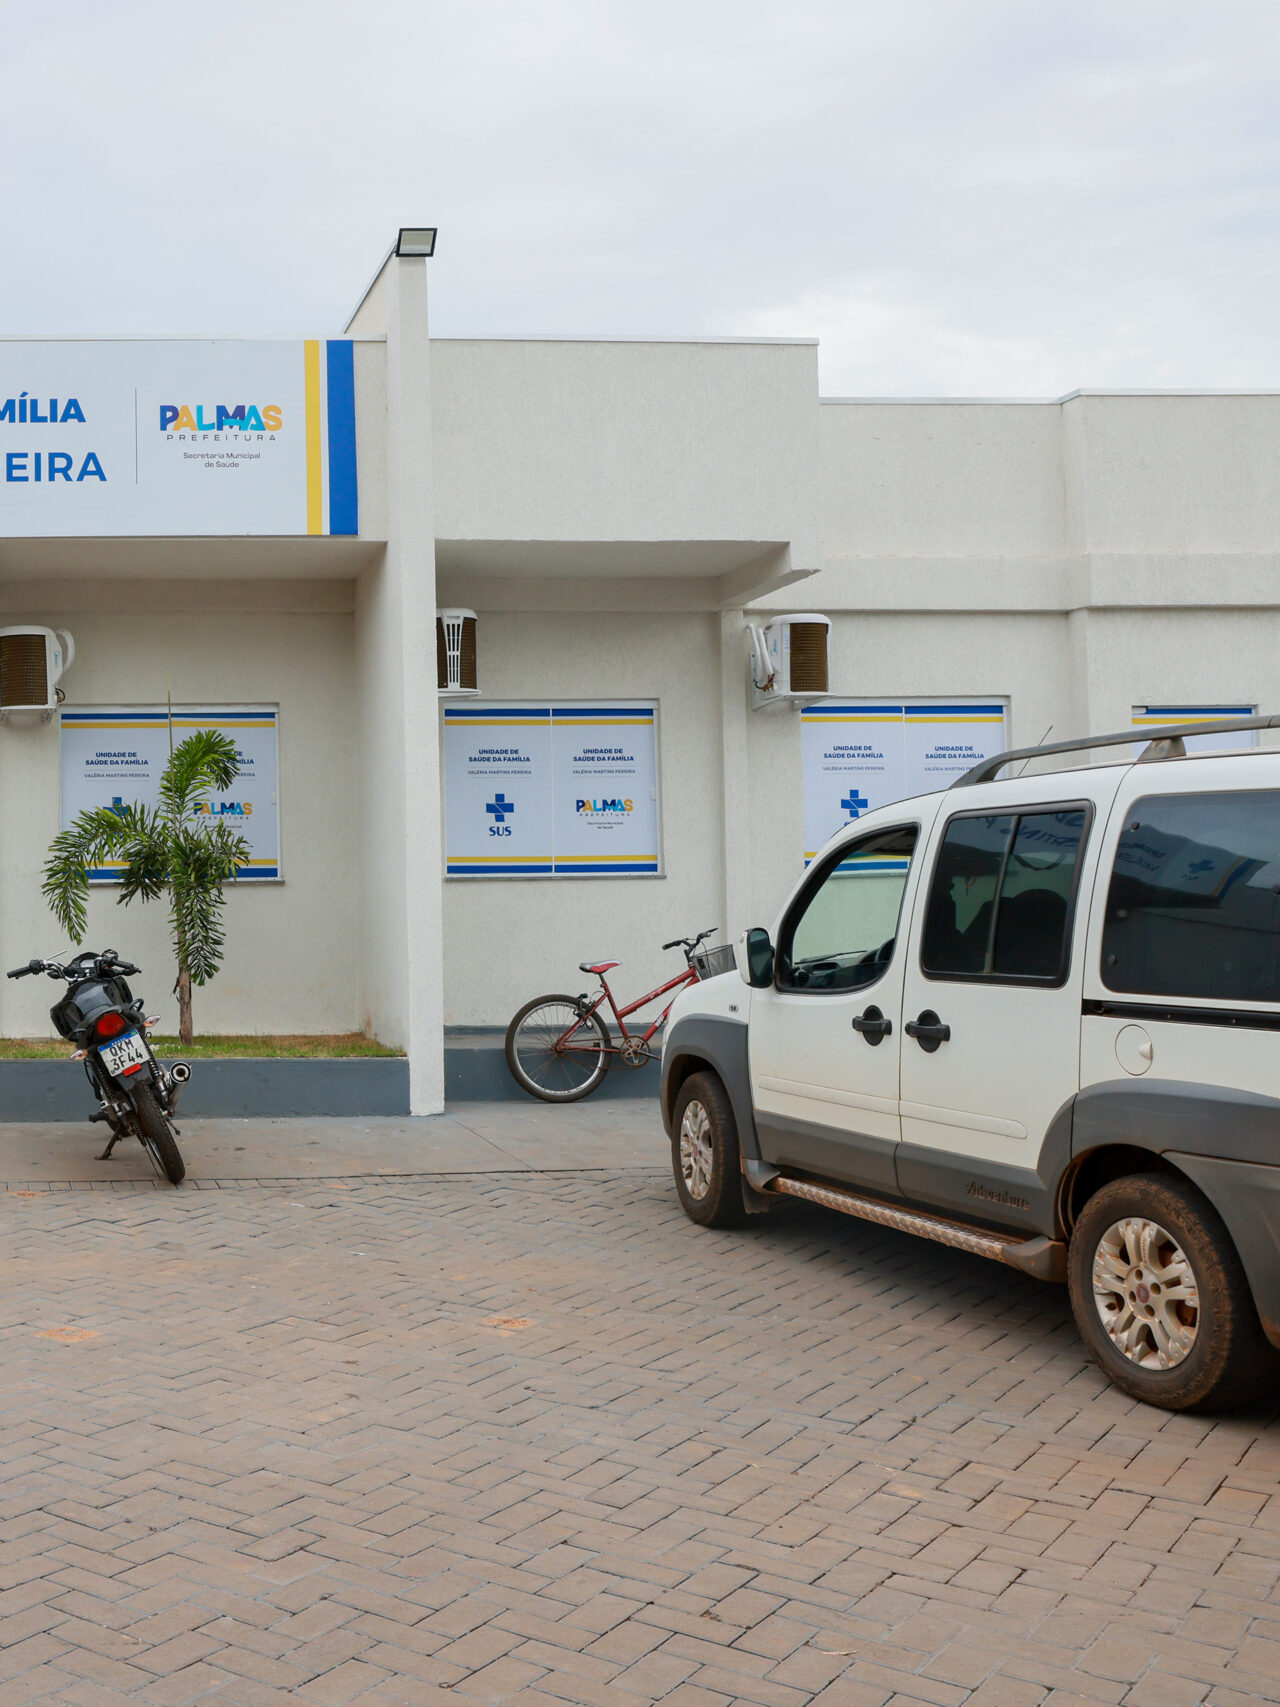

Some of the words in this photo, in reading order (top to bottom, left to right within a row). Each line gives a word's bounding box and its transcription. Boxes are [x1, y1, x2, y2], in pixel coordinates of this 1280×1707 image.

[160, 405, 282, 431] PALMAS
[226, 452, 260, 461] Municipal
[194, 803, 252, 815] PALMAS
[576, 800, 633, 812] PALMAS
[489, 826, 511, 836] SUS
[110, 1040, 134, 1056] QKM
[111, 1048, 143, 1070] 3F44
